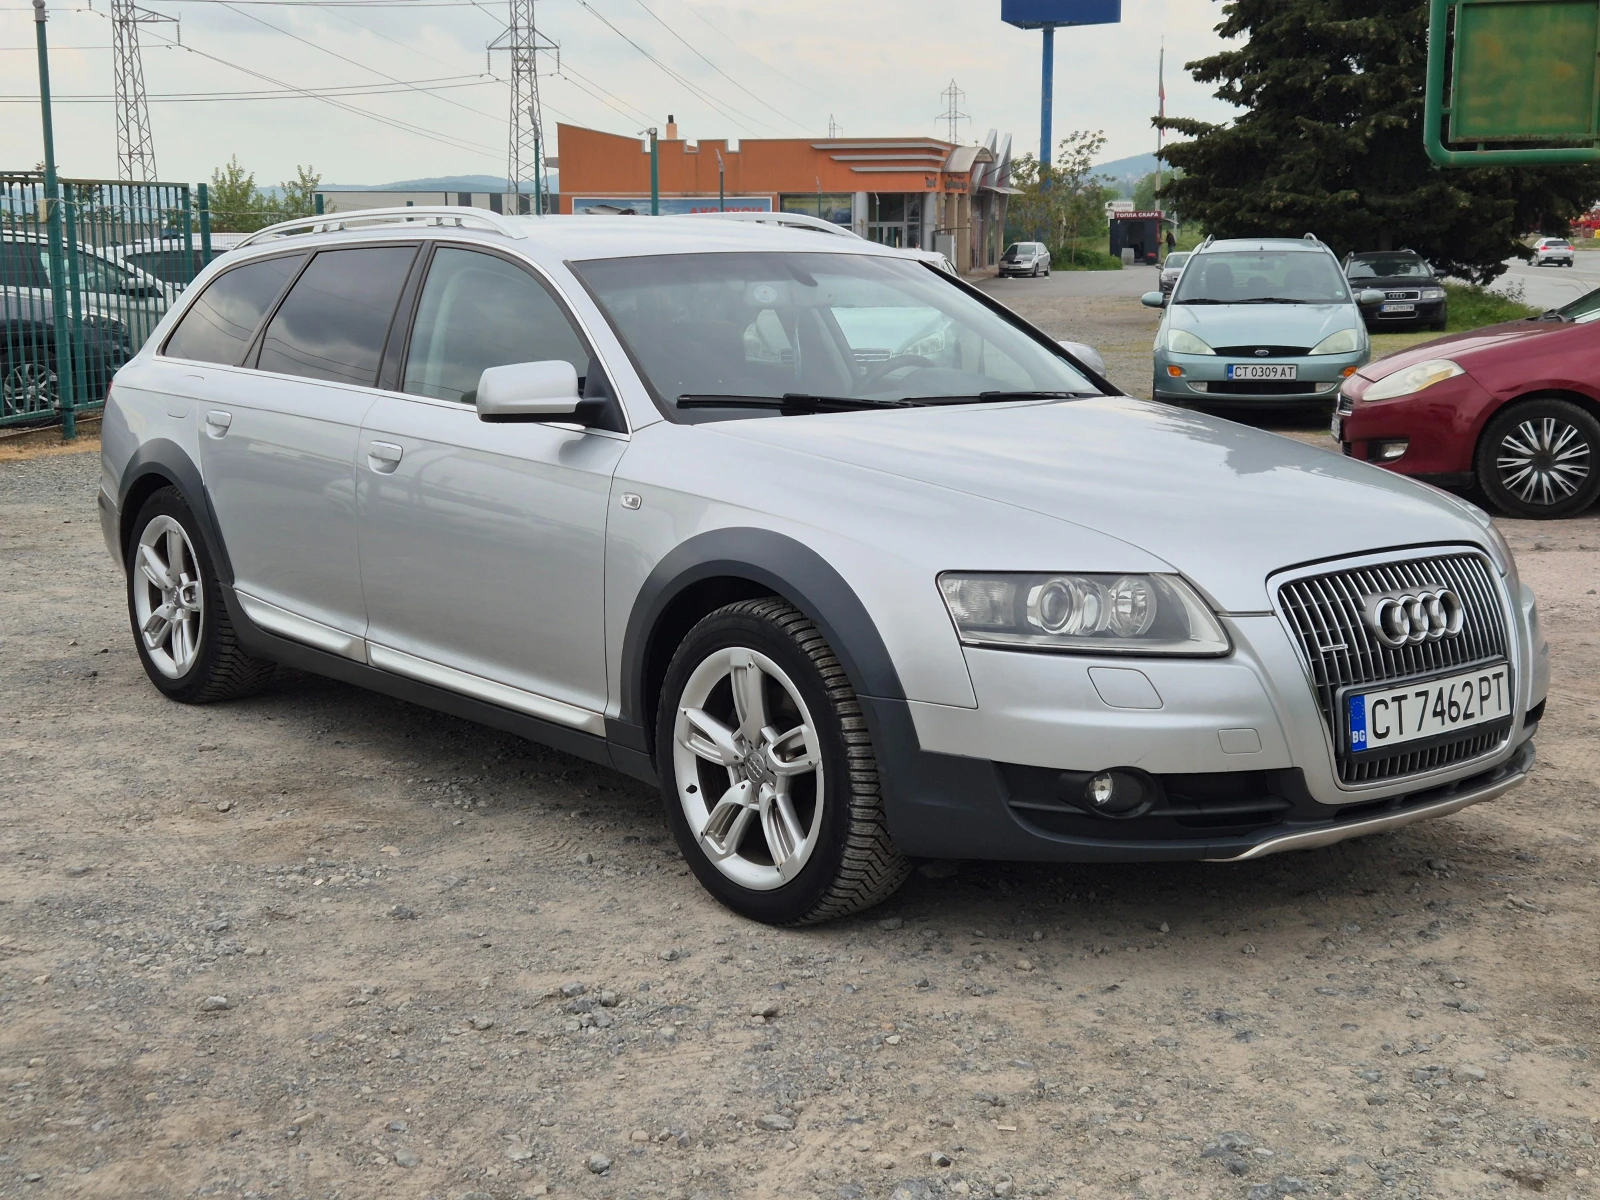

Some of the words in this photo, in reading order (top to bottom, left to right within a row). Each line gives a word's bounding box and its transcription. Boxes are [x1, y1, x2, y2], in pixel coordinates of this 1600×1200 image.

[1234, 366, 1249, 377] CT
[1251, 366, 1278, 377] 0309
[1280, 366, 1294, 377] AT
[1371, 694, 1408, 740] CT
[1414, 680, 1476, 732] 7462
[1478, 671, 1504, 716] PT
[1352, 730, 1366, 744] BG
